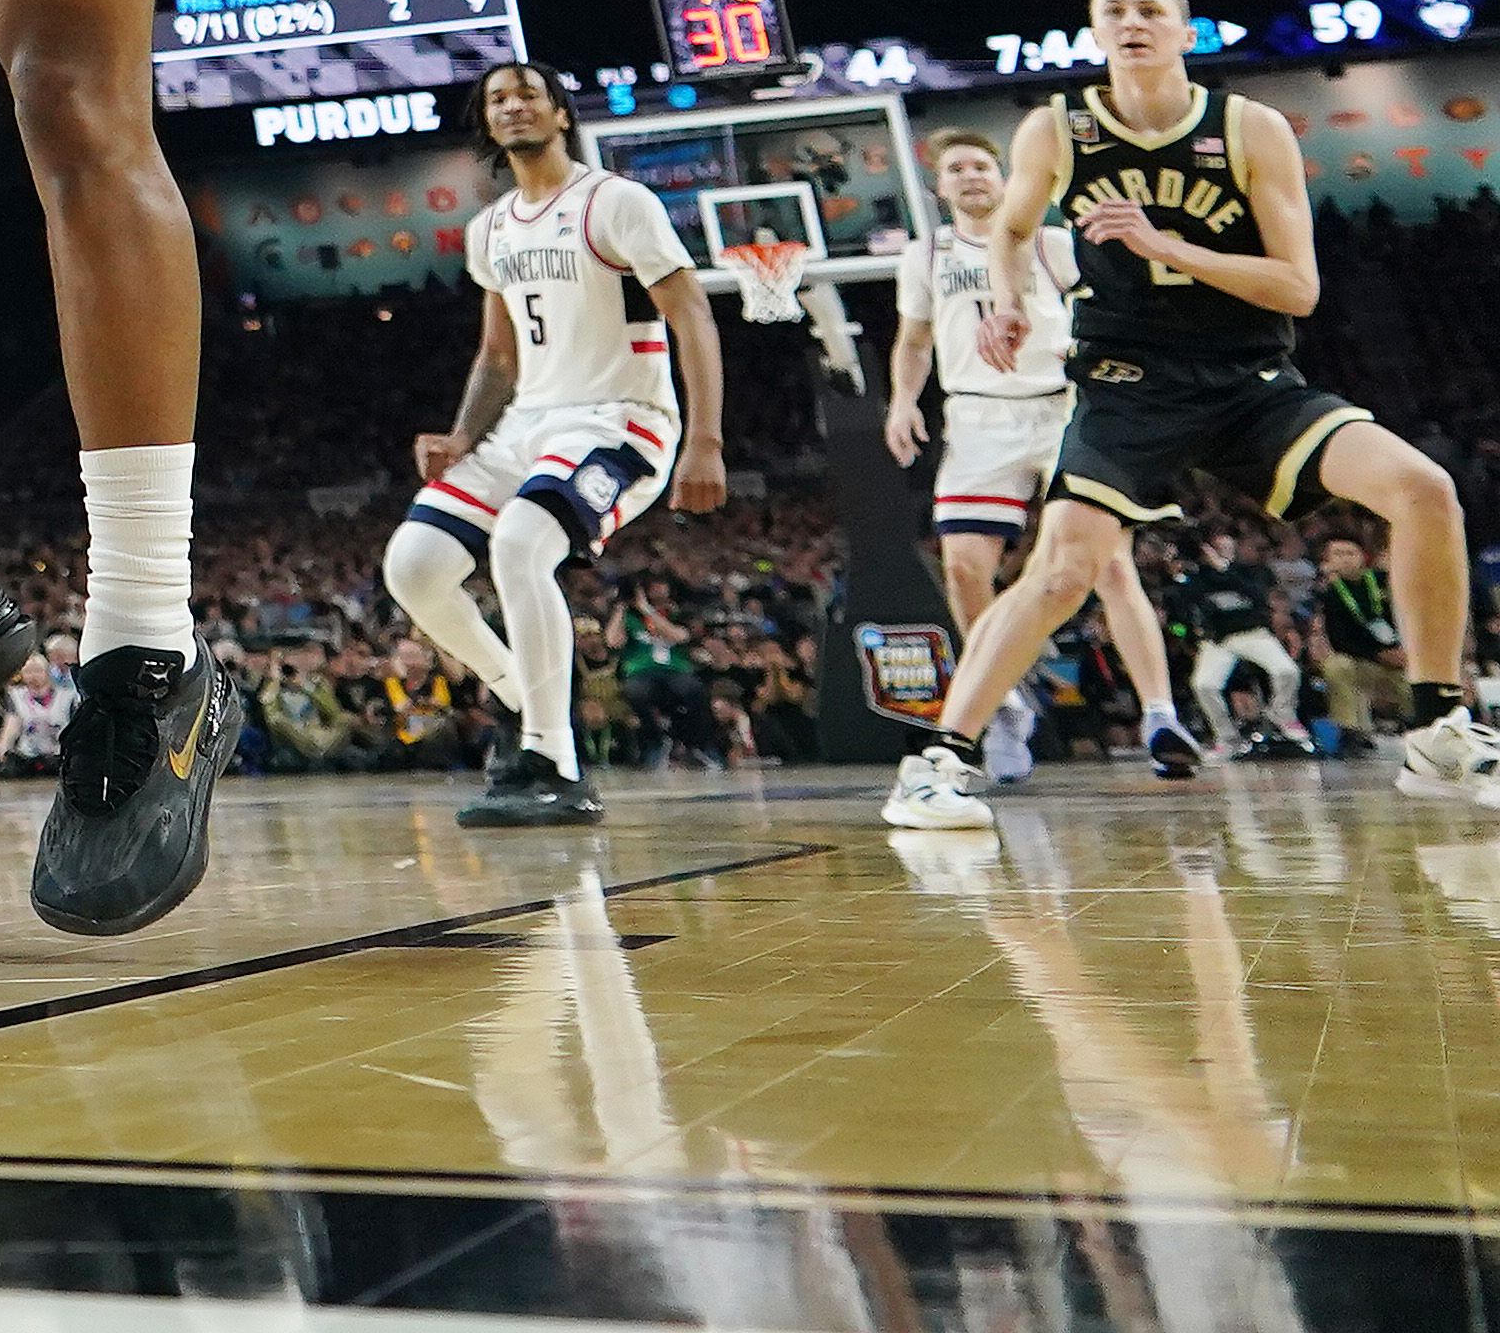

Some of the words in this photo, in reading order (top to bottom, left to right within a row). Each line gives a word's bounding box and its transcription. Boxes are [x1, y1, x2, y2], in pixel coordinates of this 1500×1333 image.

[173, 11, 239, 45] 9/11
[682, 2, 771, 67] 30
[1308, 0, 1382, 45] 59
[845, 44, 917, 87] 44
[986, 27, 1107, 74] 7:44
[252, 91, 441, 147] PURDUE
[525, 293, 547, 346] 5
